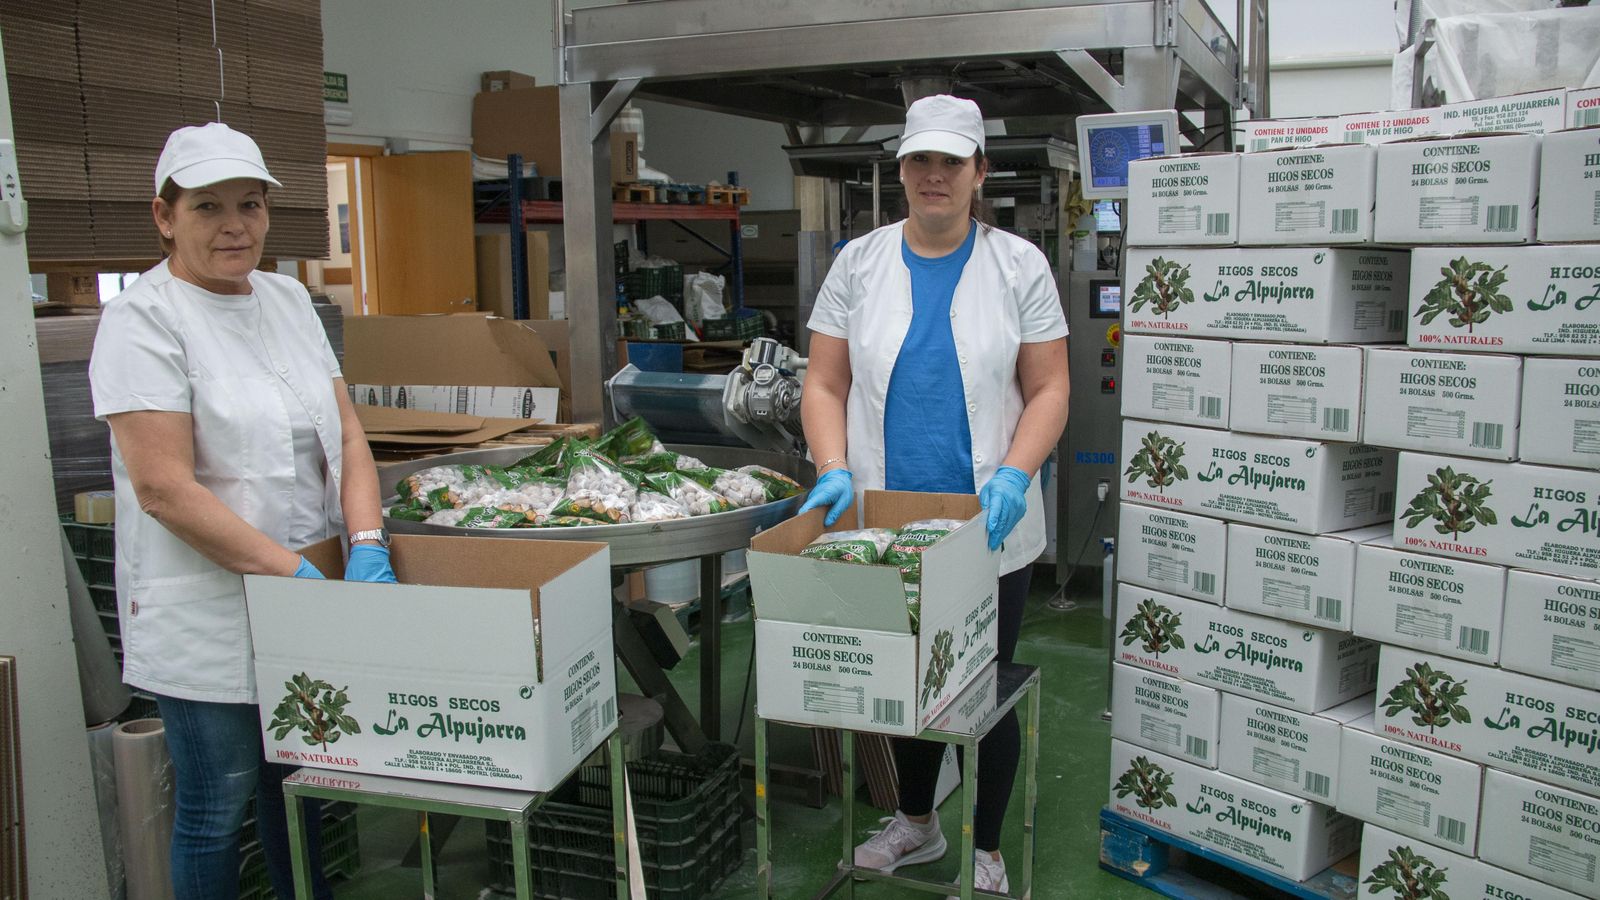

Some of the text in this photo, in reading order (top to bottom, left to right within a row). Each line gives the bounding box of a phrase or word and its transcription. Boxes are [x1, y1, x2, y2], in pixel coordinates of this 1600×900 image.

[1444, 111, 1460, 119] IND.
[1462, 106, 1499, 116] HIGUERA
[1501, 96, 1560, 112] ALPUJARREÑA
[1346, 121, 1380, 130] CONTIENE
[1393, 117, 1430, 126] UNIDADES
[1423, 144, 1480, 157] CONTIENE:
[1159, 162, 1200, 173] CONTIENE:
[1276, 154, 1324, 166] CONTIENE:
[1412, 160, 1491, 175] HIGOS SECOS
[1152, 175, 1208, 188] HIGOS SECOS
[1268, 168, 1334, 182] HIGOS SECOS
[1420, 177, 1448, 186] BOLSAS
[1455, 177, 1467, 185] 500
[1218, 266, 1298, 277] HIGOS SECOS
[1203, 279, 1314, 304] La Alpujarra
[1527, 283, 1566, 311] La
[1130, 320, 1188, 330] 100% NATURALES
[1154, 342, 1194, 353] CONTIENE:
[1419, 334, 1503, 346] 100% NATURALES
[1146, 354, 1201, 368] HIGOS SECOS
[1268, 350, 1316, 361] CONTIENE:
[1410, 358, 1466, 371] CONTIENE:
[1260, 364, 1325, 377] HIGOS SECOS
[1400, 373, 1476, 389] HIGOS SECOS
[1564, 384, 1600, 396] HIGO
[1408, 387, 1436, 397] BOLSAS
[1442, 390, 1454, 398] 500
[1076, 451, 1115, 464] RS300
[1212, 448, 1290, 467] HIGOS SECOS
[1197, 461, 1305, 492] La Alpujarra
[1126, 490, 1182, 506] 100% NATURALES
[1534, 487, 1586, 503] HIGOS
[1149, 514, 1188, 528] CONTIENE:
[1511, 503, 1549, 528] La
[1142, 525, 1196, 544] HIGOS SECOS
[1264, 535, 1310, 550] CONTIENE:
[1405, 536, 1487, 556] 100% NATURALES
[1255, 547, 1319, 567] HIGOS SECOS
[1400, 558, 1454, 576] CONTIENE:
[1389, 571, 1464, 594] HIGOS SECOS
[1544, 599, 1586, 616] HIGOS
[1554, 616, 1585, 628] BOLSAS
[802, 632, 862, 646] CONTIENE:
[1208, 621, 1287, 648] HIGOS SECOS
[792, 646, 874, 665] HIGOS SECOS
[1193, 634, 1303, 672] La Alpujarra
[802, 662, 832, 672] BOLSAS
[838, 666, 851, 674] 500
[1121, 652, 1178, 674] 100% NATURALES
[1142, 676, 1181, 694] CONTIENE:
[388, 692, 500, 713] HIGOS SECOS
[1135, 686, 1188, 709] HIGOS SECOS
[1505, 692, 1555, 713] HIGOS
[1255, 707, 1300, 727] CONTIENE:
[372, 709, 526, 744] La Alpujarra
[1247, 717, 1308, 743] HIGOS SECOS
[1484, 707, 1600, 754] La Alpuj
[1384, 724, 1462, 752] 100% NATURALES
[276, 750, 358, 767] 100% NATURALES
[1380, 745, 1432, 767] CONTIENE:
[490, 772, 522, 780] (GRANADA)
[1370, 755, 1441, 785] HIGOS SECOS
[1378, 770, 1403, 784] BOLSAS
[1409, 780, 1420, 789] 500
[1200, 784, 1276, 817] HIGOS SECOS
[1535, 789, 1598, 815] CONTIENE:
[1132, 809, 1171, 830] NATURALES
[1185, 796, 1291, 842] La Alpujarra
[1522, 800, 1600, 833] HIGOS SECO
[1531, 818, 1562, 832] BOLSAS
[1570, 830, 1583, 839] 500
